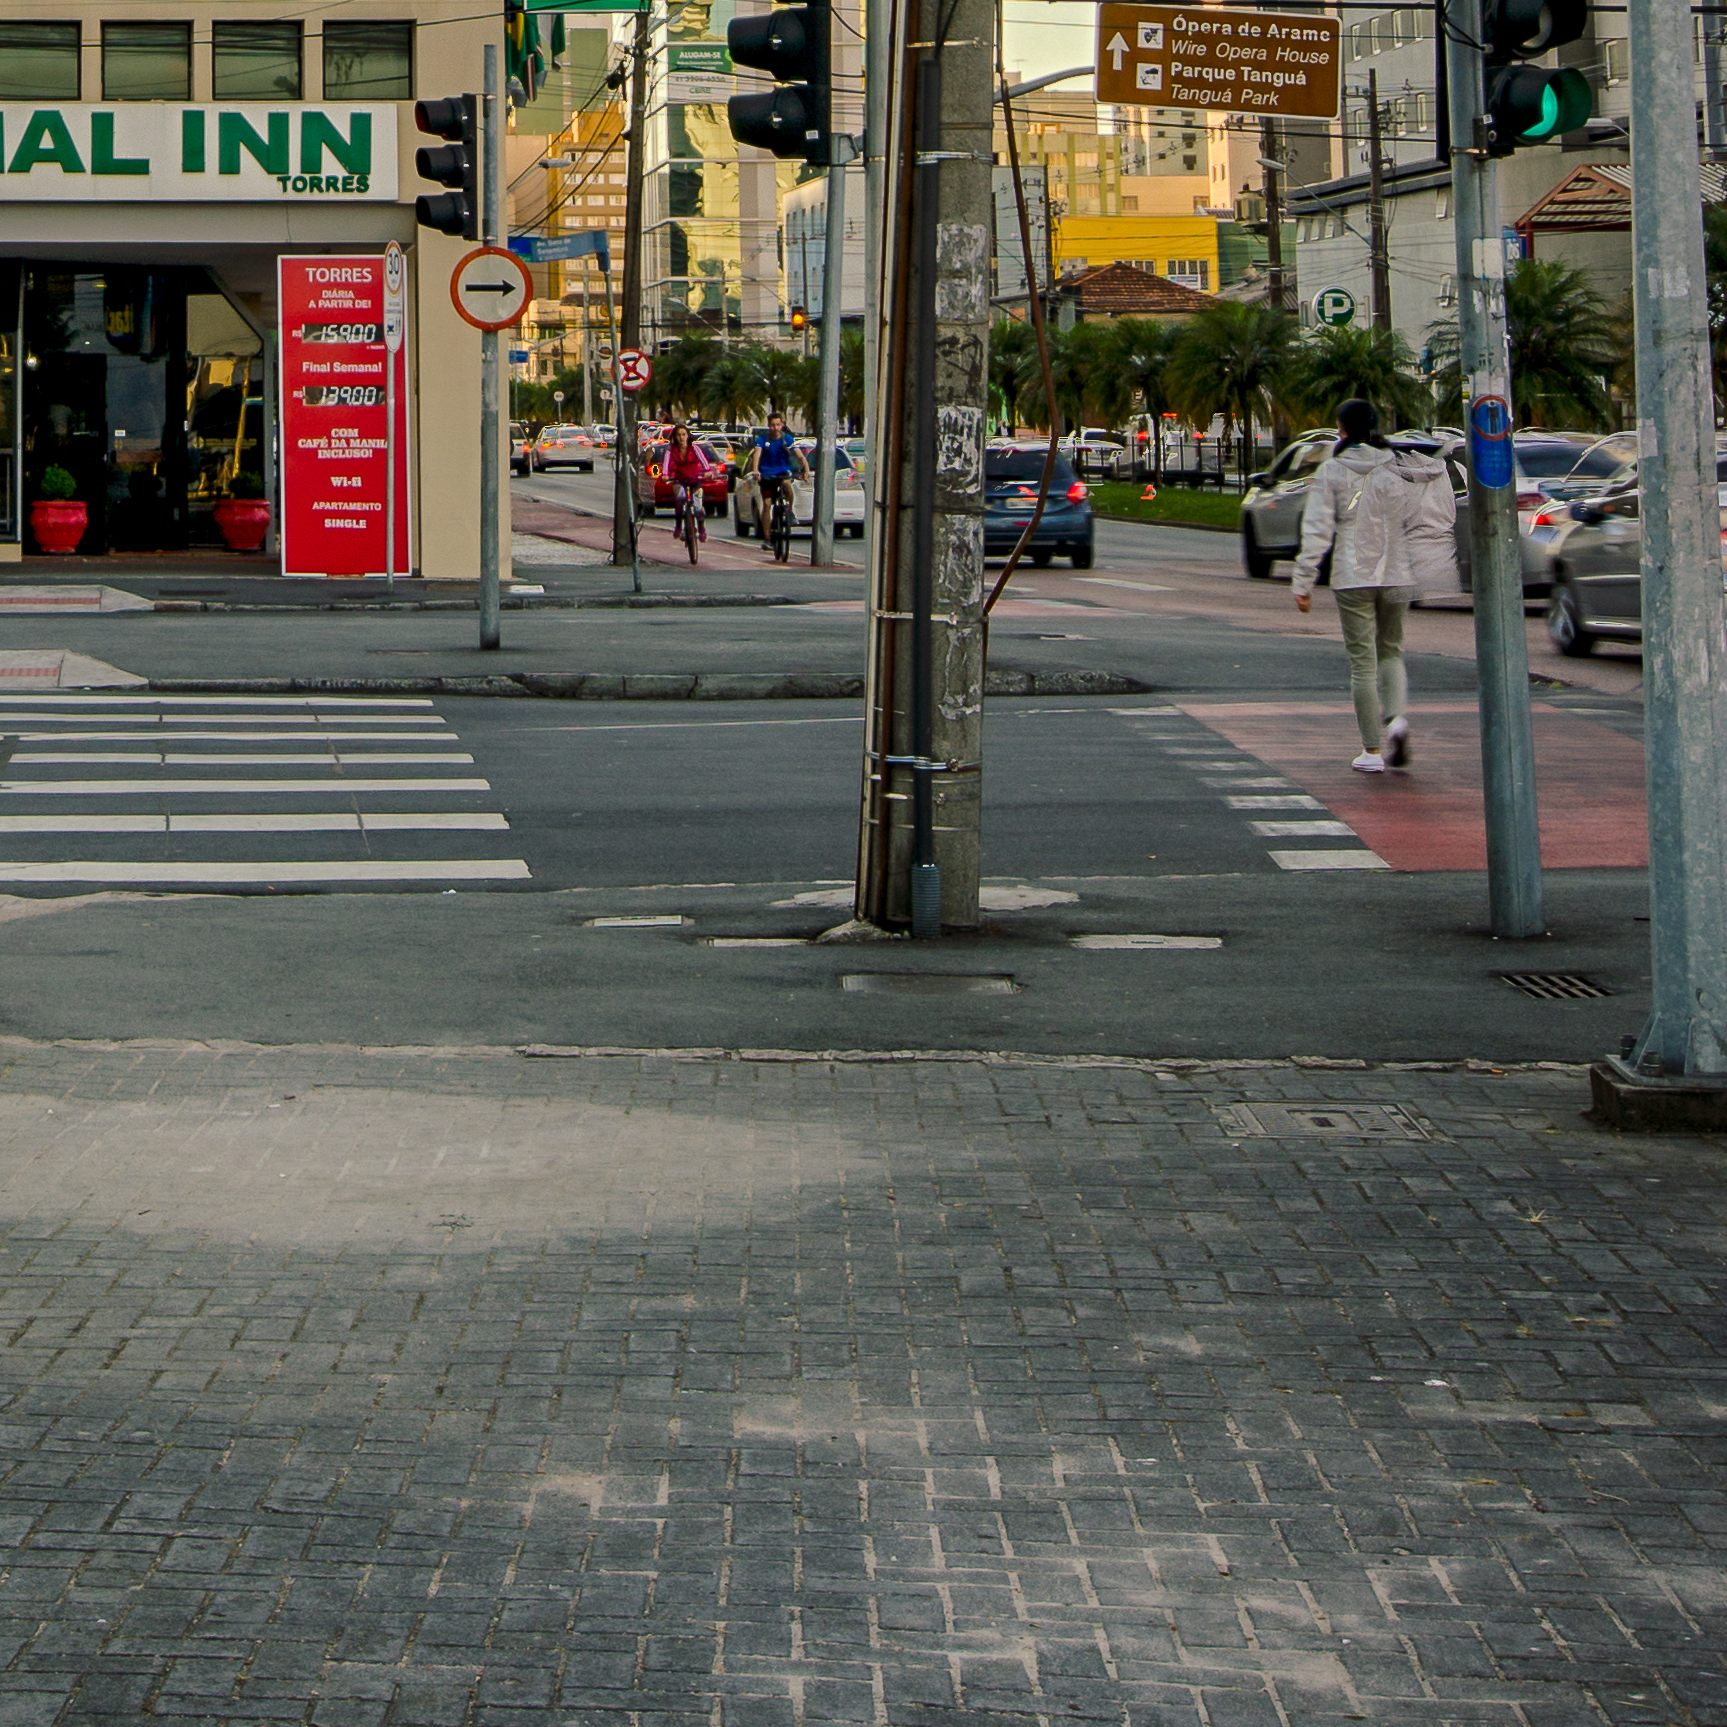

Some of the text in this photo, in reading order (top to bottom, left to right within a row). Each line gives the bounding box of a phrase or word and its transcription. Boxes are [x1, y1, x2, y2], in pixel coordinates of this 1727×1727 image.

[1172, 13, 1232, 36] Ópera
[1238, 22, 1261, 37] de
[1171, 39, 1330, 64] Wire Opera House
[1170, 62, 1307, 87] Parque Tanguá
[1171, 84, 1279, 106] Tanguá Park
[181, 110, 372, 177] INN
[276, 174, 370, 193] TORRES
[389, 253, 400, 274] 30
[305, 267, 372, 283] TORRES
[321, 288, 355, 298] DIÁRIA
[308, 300, 316, 308] A
[318, 299, 353, 308] PARTIR
[302, 361, 330, 373] Final
[330, 428, 359, 437] COM
[297, 436, 329, 448] CAFÉ
[331, 438, 347, 448] DA
[312, 501, 382, 511] APARTAMENTO
[324, 518, 367, 529] SINGLE
